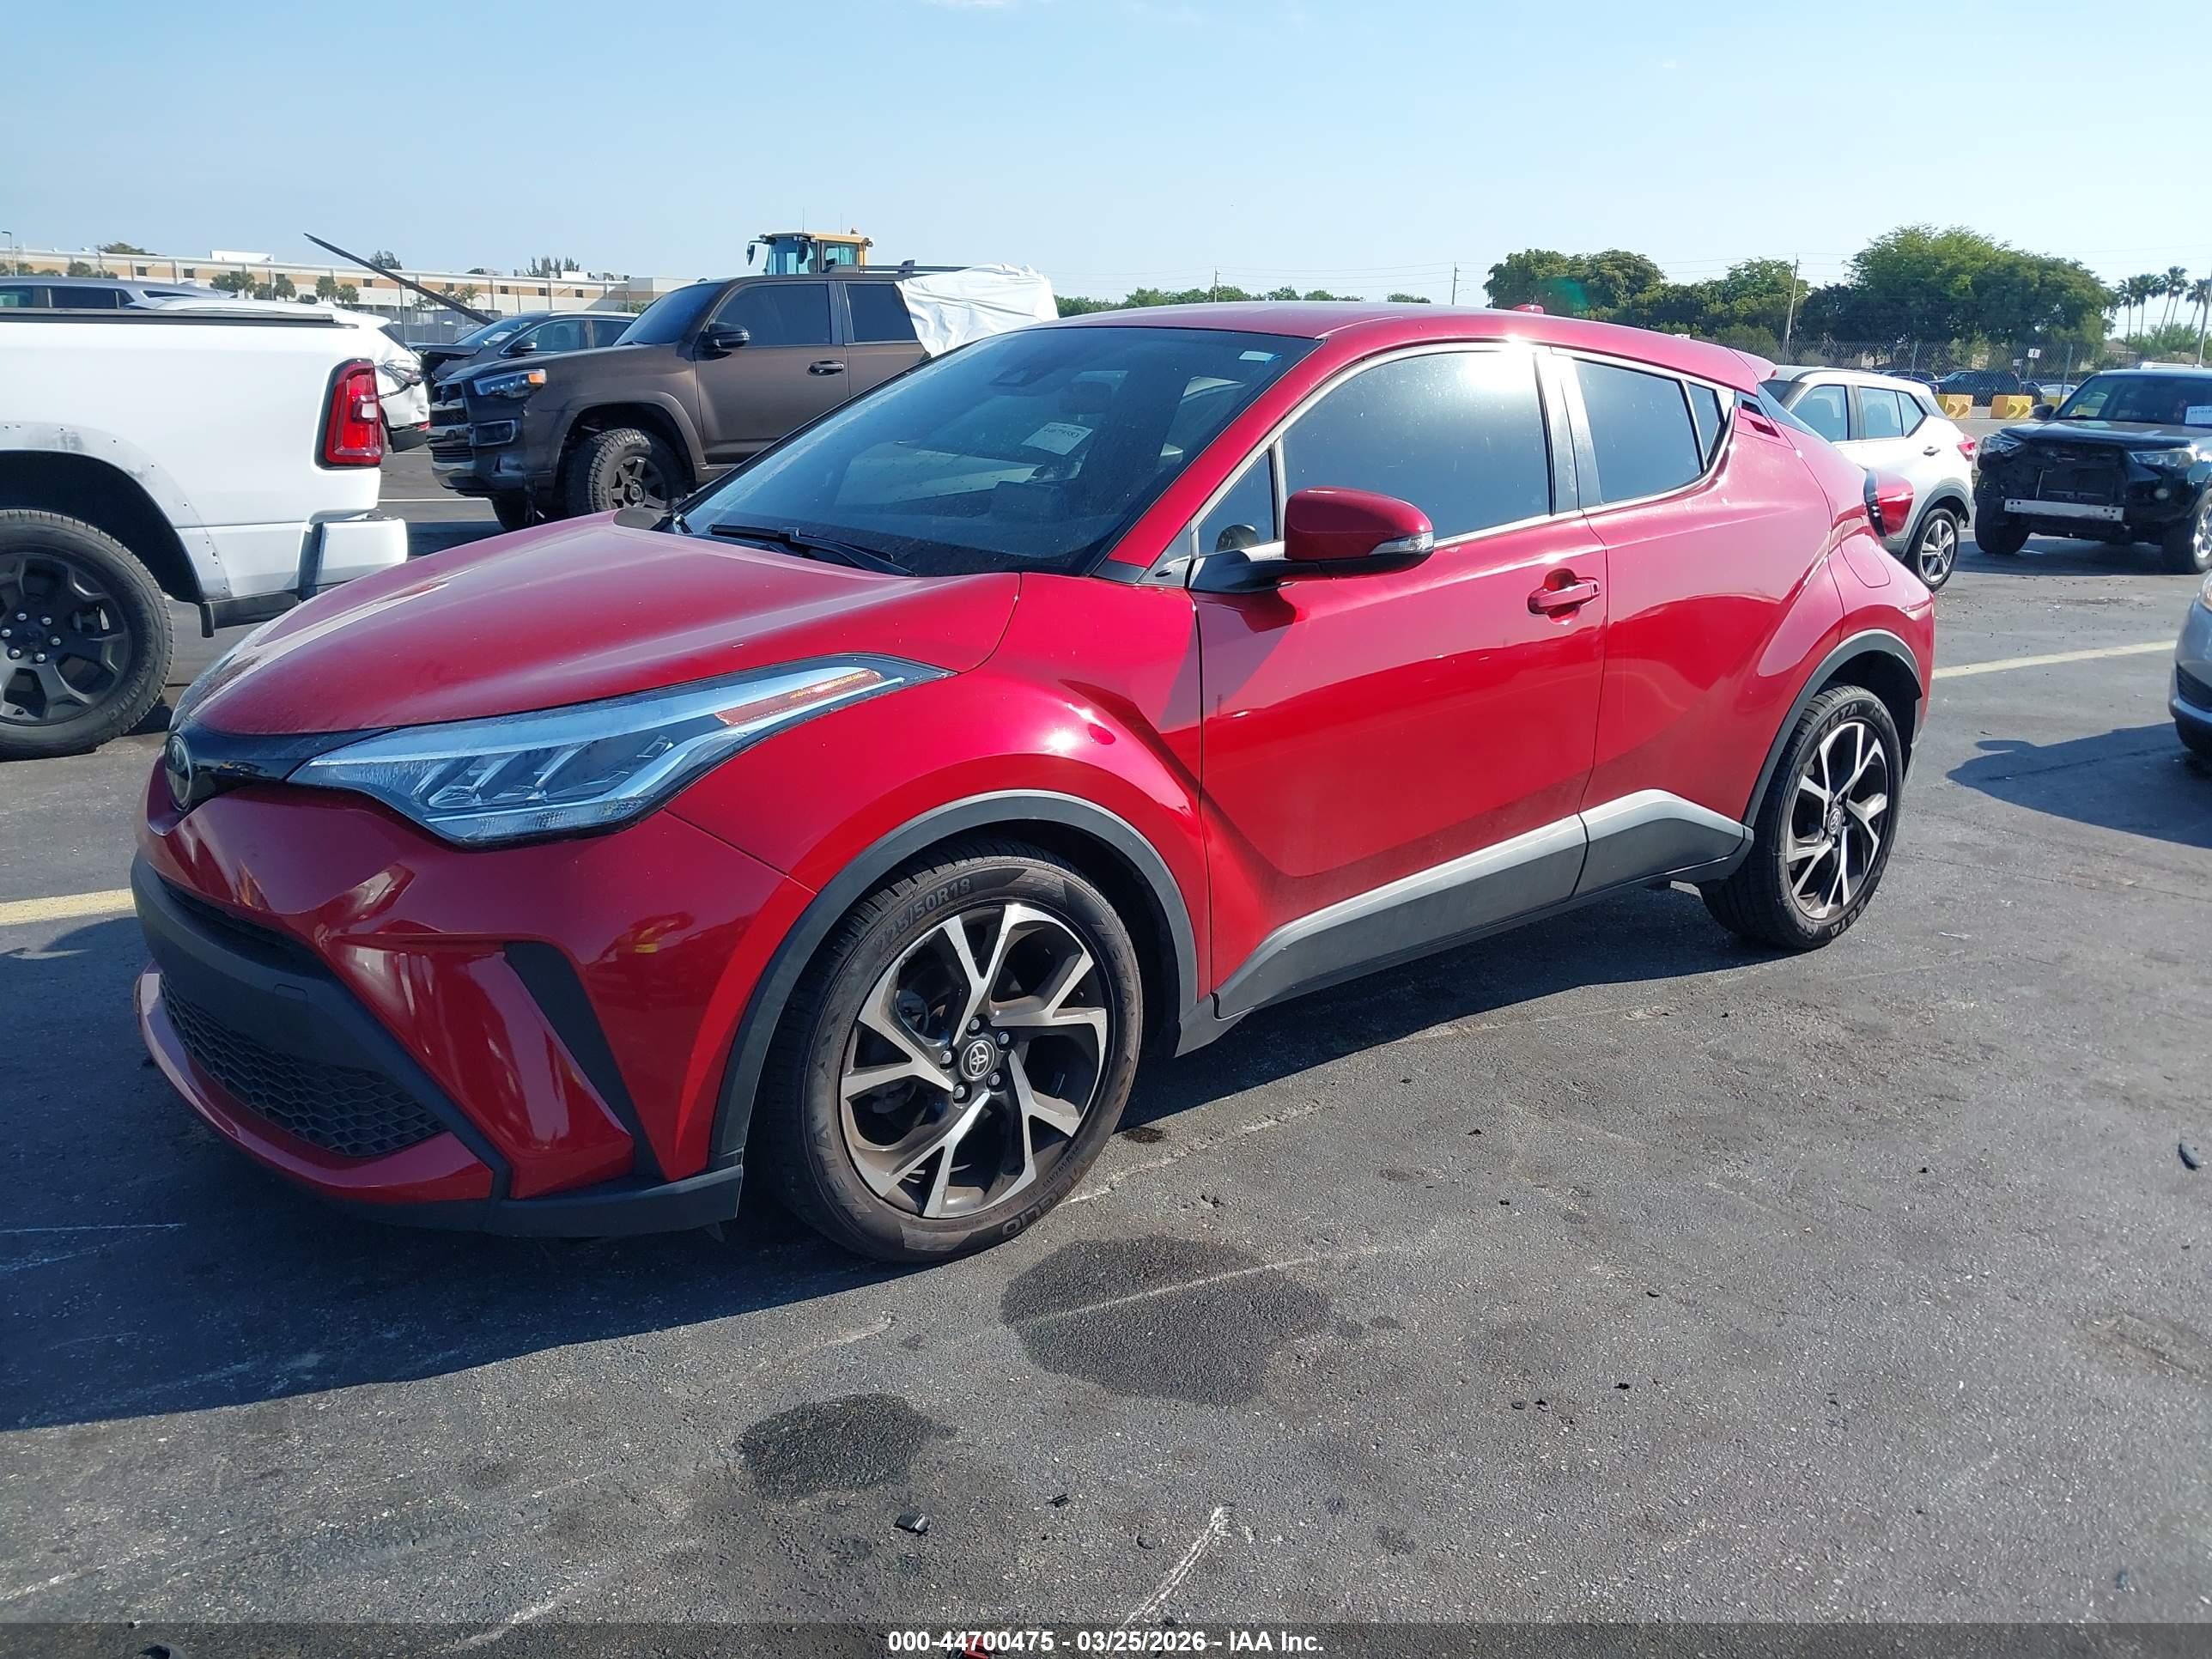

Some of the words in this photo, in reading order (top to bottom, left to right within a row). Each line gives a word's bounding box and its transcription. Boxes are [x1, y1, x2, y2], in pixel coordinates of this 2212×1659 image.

[1820, 703, 1857, 738] ZETA
[872, 878, 972, 953] 225/50R18
[1830, 896, 1867, 937] ZETA
[1091, 916, 1134, 1009] ZETA
[812, 1121, 872, 1223] ZETA
